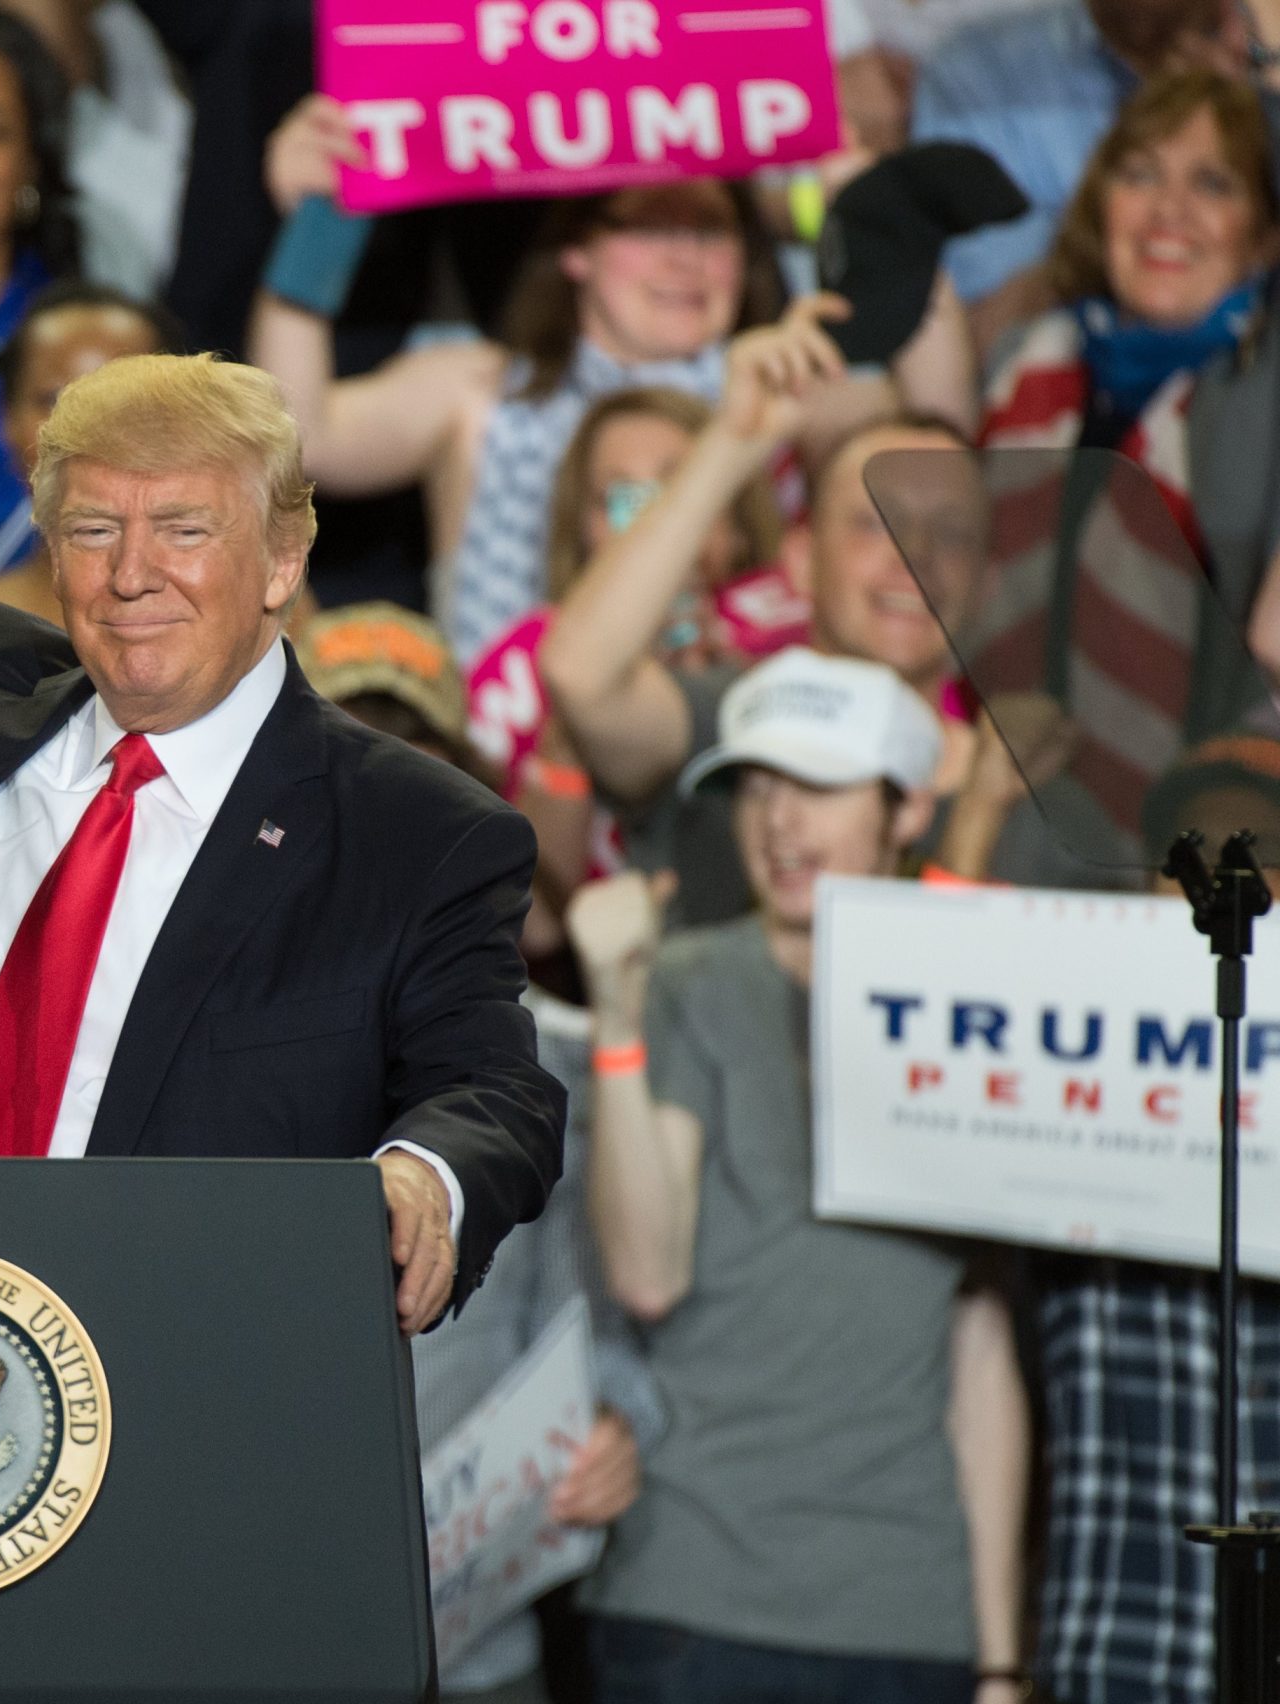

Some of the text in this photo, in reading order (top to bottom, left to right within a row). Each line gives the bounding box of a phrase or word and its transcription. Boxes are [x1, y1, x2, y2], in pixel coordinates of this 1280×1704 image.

[475, 0, 663, 65] FOR
[345, 77, 814, 181] TRUMP
[906, 1061, 1260, 1131] PENCE
[28, 1301, 100, 1447] UNITED
